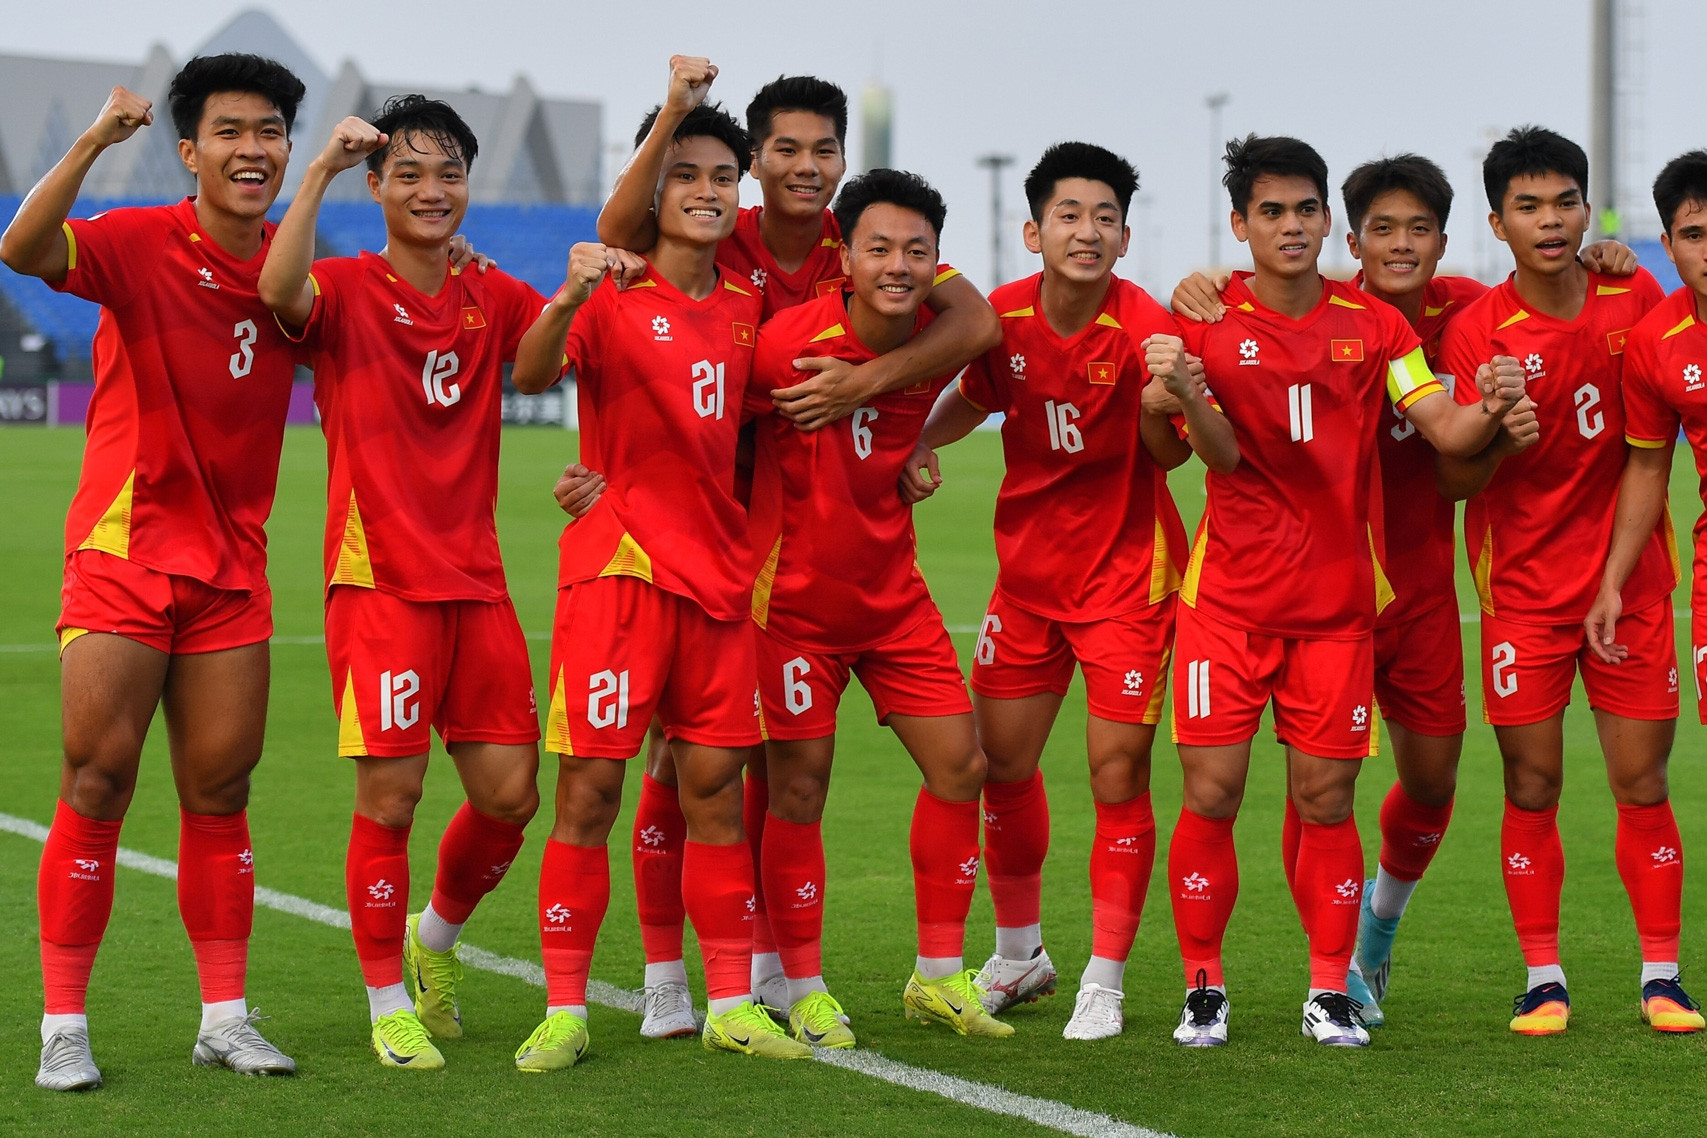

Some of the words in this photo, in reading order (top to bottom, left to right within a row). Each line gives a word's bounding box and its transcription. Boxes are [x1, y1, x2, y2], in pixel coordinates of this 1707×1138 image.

[229, 320, 258, 379] 3
[422, 349, 461, 408] 12
[692, 359, 725, 420] 21
[1288, 383, 1314, 443] 11
[1573, 382, 1605, 440] 2
[852, 407, 878, 461] 6
[1045, 400, 1084, 454] 16
[974, 612, 1003, 665] 6
[783, 656, 812, 716] 6
[1188, 659, 1211, 719] 11
[1492, 641, 1518, 698] 2
[380, 669, 420, 732] 12
[588, 669, 629, 730] 21
